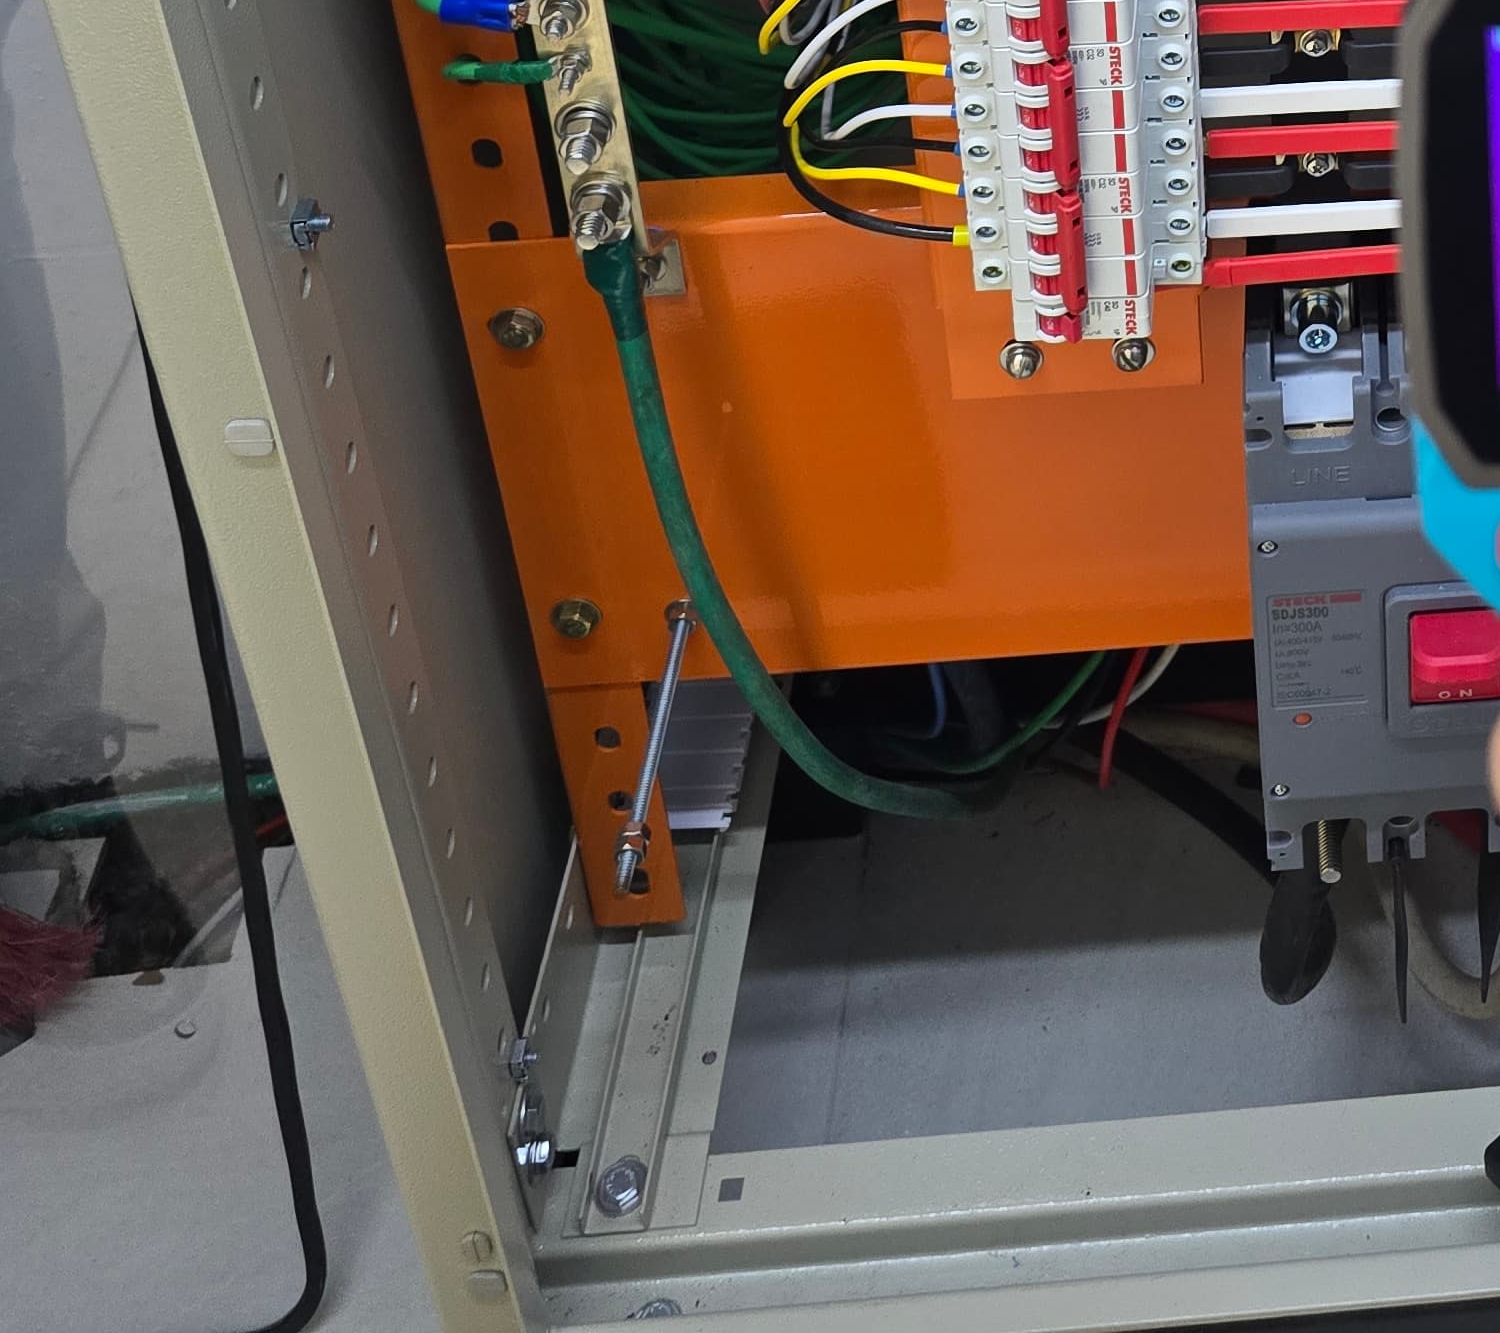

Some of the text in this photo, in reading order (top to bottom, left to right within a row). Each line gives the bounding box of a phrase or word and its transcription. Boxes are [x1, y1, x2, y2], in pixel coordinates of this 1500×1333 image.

[1108, 45, 1123, 87] STECK
[1117, 177, 1133, 215] STECK
[1124, 299, 1138, 337] STECK
[1292, 466, 1351, 485] LINE
[1271, 606, 1329, 620] SDJS300
[1272, 596, 1328, 608] STECK
